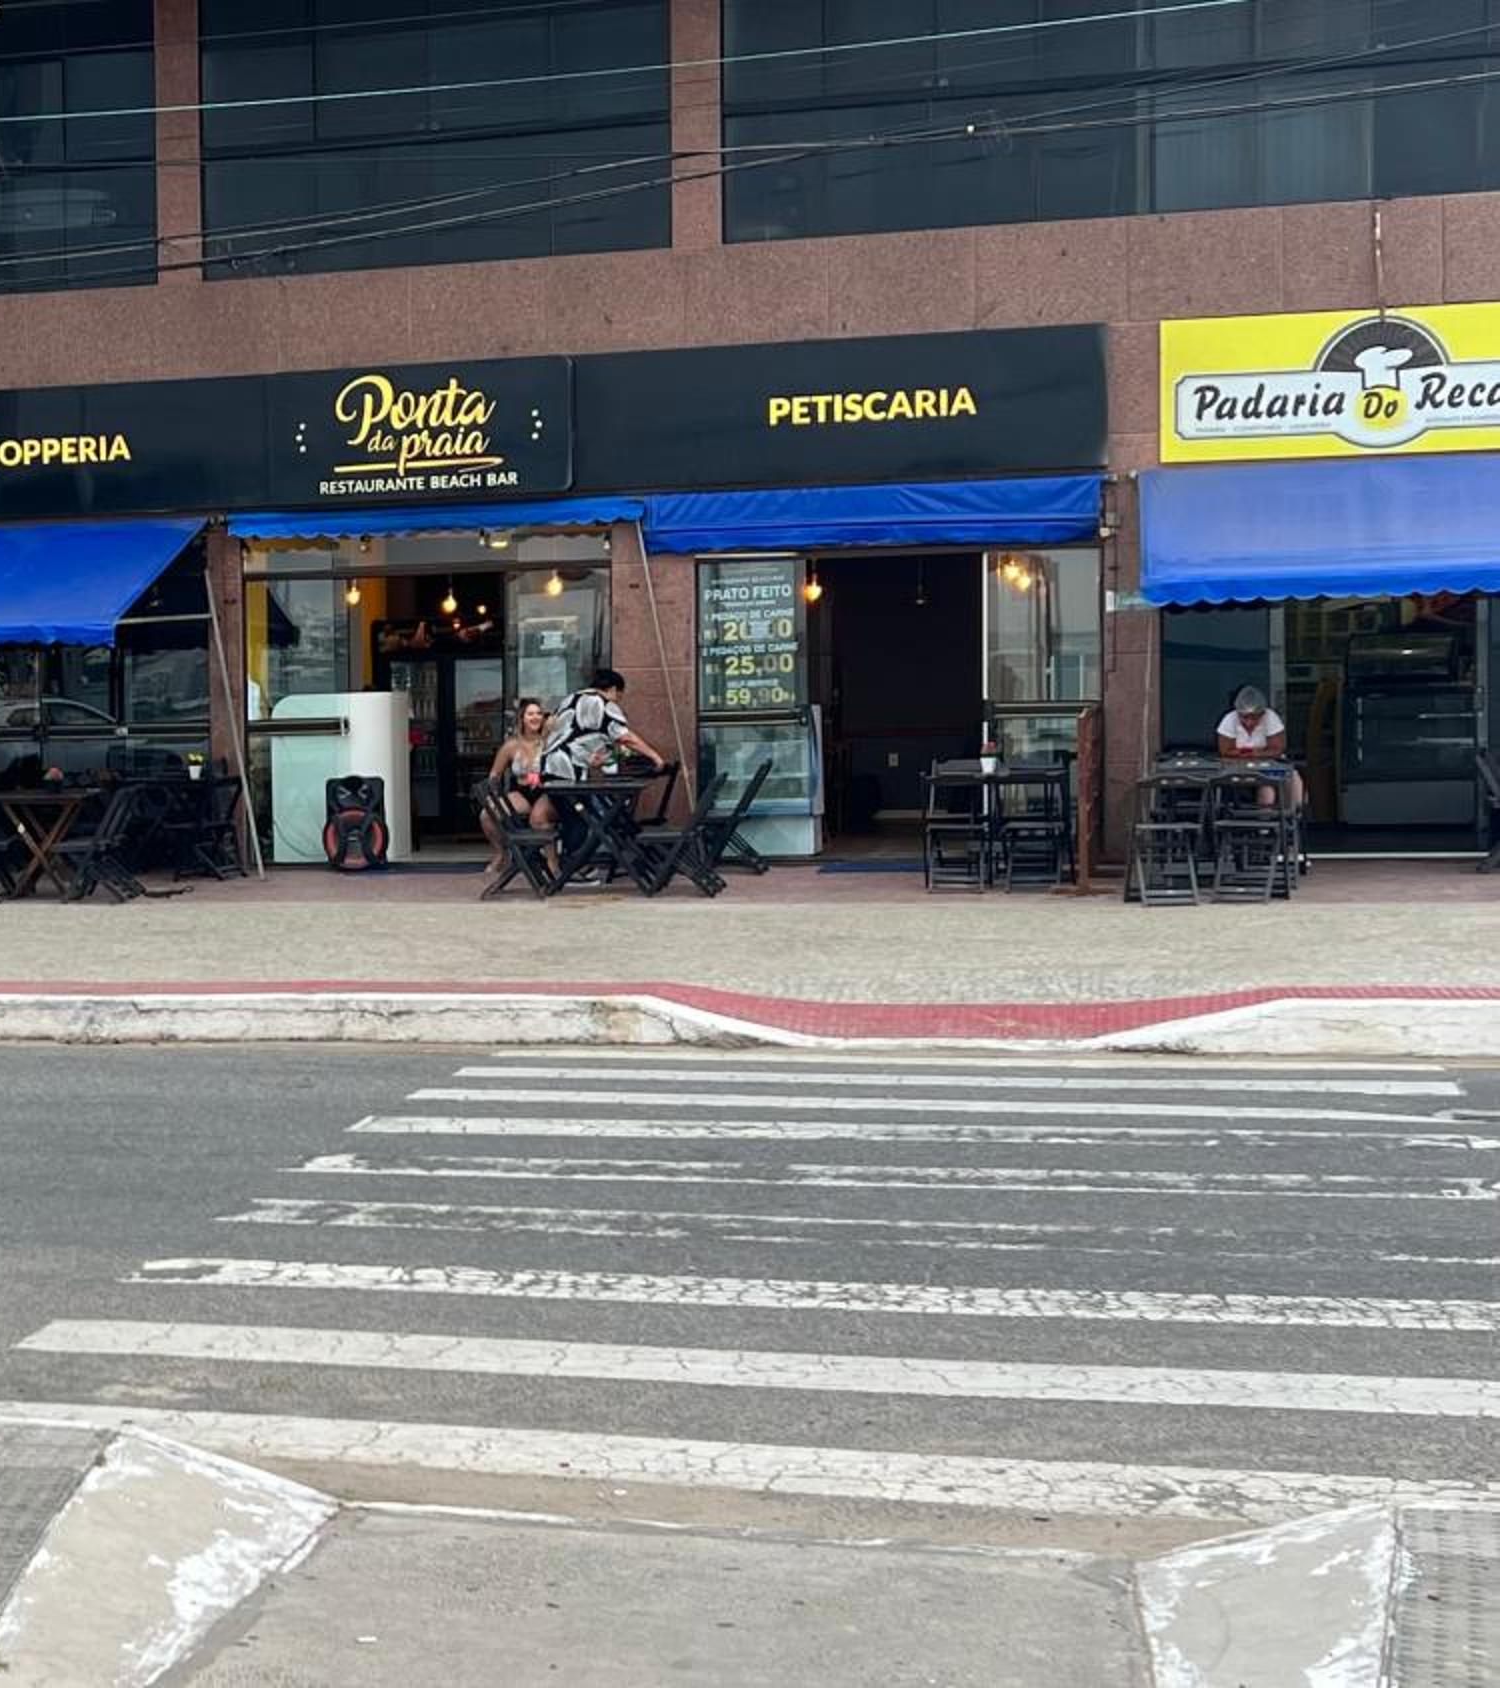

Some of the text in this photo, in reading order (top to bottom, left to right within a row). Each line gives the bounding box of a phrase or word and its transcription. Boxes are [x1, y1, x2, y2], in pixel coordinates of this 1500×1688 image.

[334, 374, 497, 446] Ponta
[768, 386, 977, 427] PETISCARIA
[1194, 383, 1345, 421] Padaria
[1363, 392, 1398, 419] Do
[367, 427, 490, 477] da praia
[319, 470, 519, 496] RESTAURANTE BEACH BAR
[704, 583, 792, 601] PRATO FEITO
[725, 653, 795, 677] 25,00
